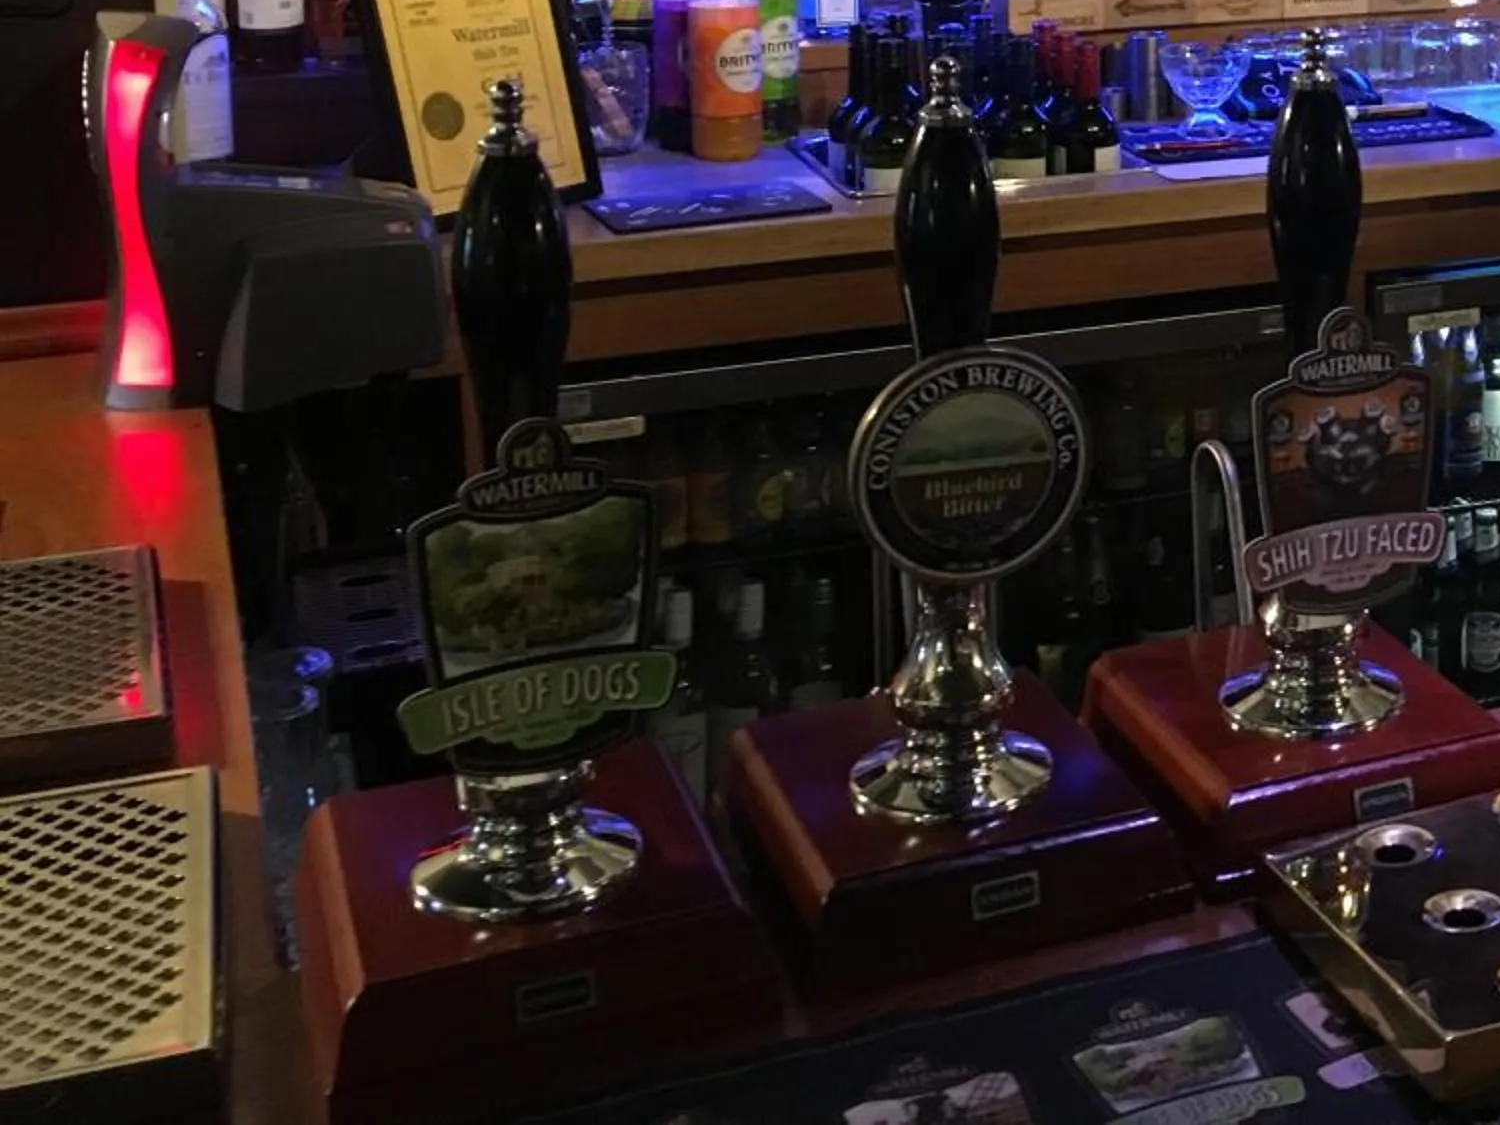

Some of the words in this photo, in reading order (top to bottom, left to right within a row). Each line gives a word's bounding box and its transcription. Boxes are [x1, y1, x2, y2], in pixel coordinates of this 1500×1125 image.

[1300, 352, 1394, 383] WATERMILL
[868, 370, 960, 491] CONISTON
[966, 365, 1073, 431] BREWING
[471, 471, 600, 507] WATERMILL
[924, 472, 1023, 500] Bluebird
[943, 494, 1007, 519] Bitter
[1256, 537, 1312, 582] SHIH
[1319, 526, 1360, 562] TZU
[1366, 520, 1436, 556] FACED
[439, 686, 501, 737] ISLE
[513, 669, 553, 716] OF
[560, 660, 642, 708] DOGS
